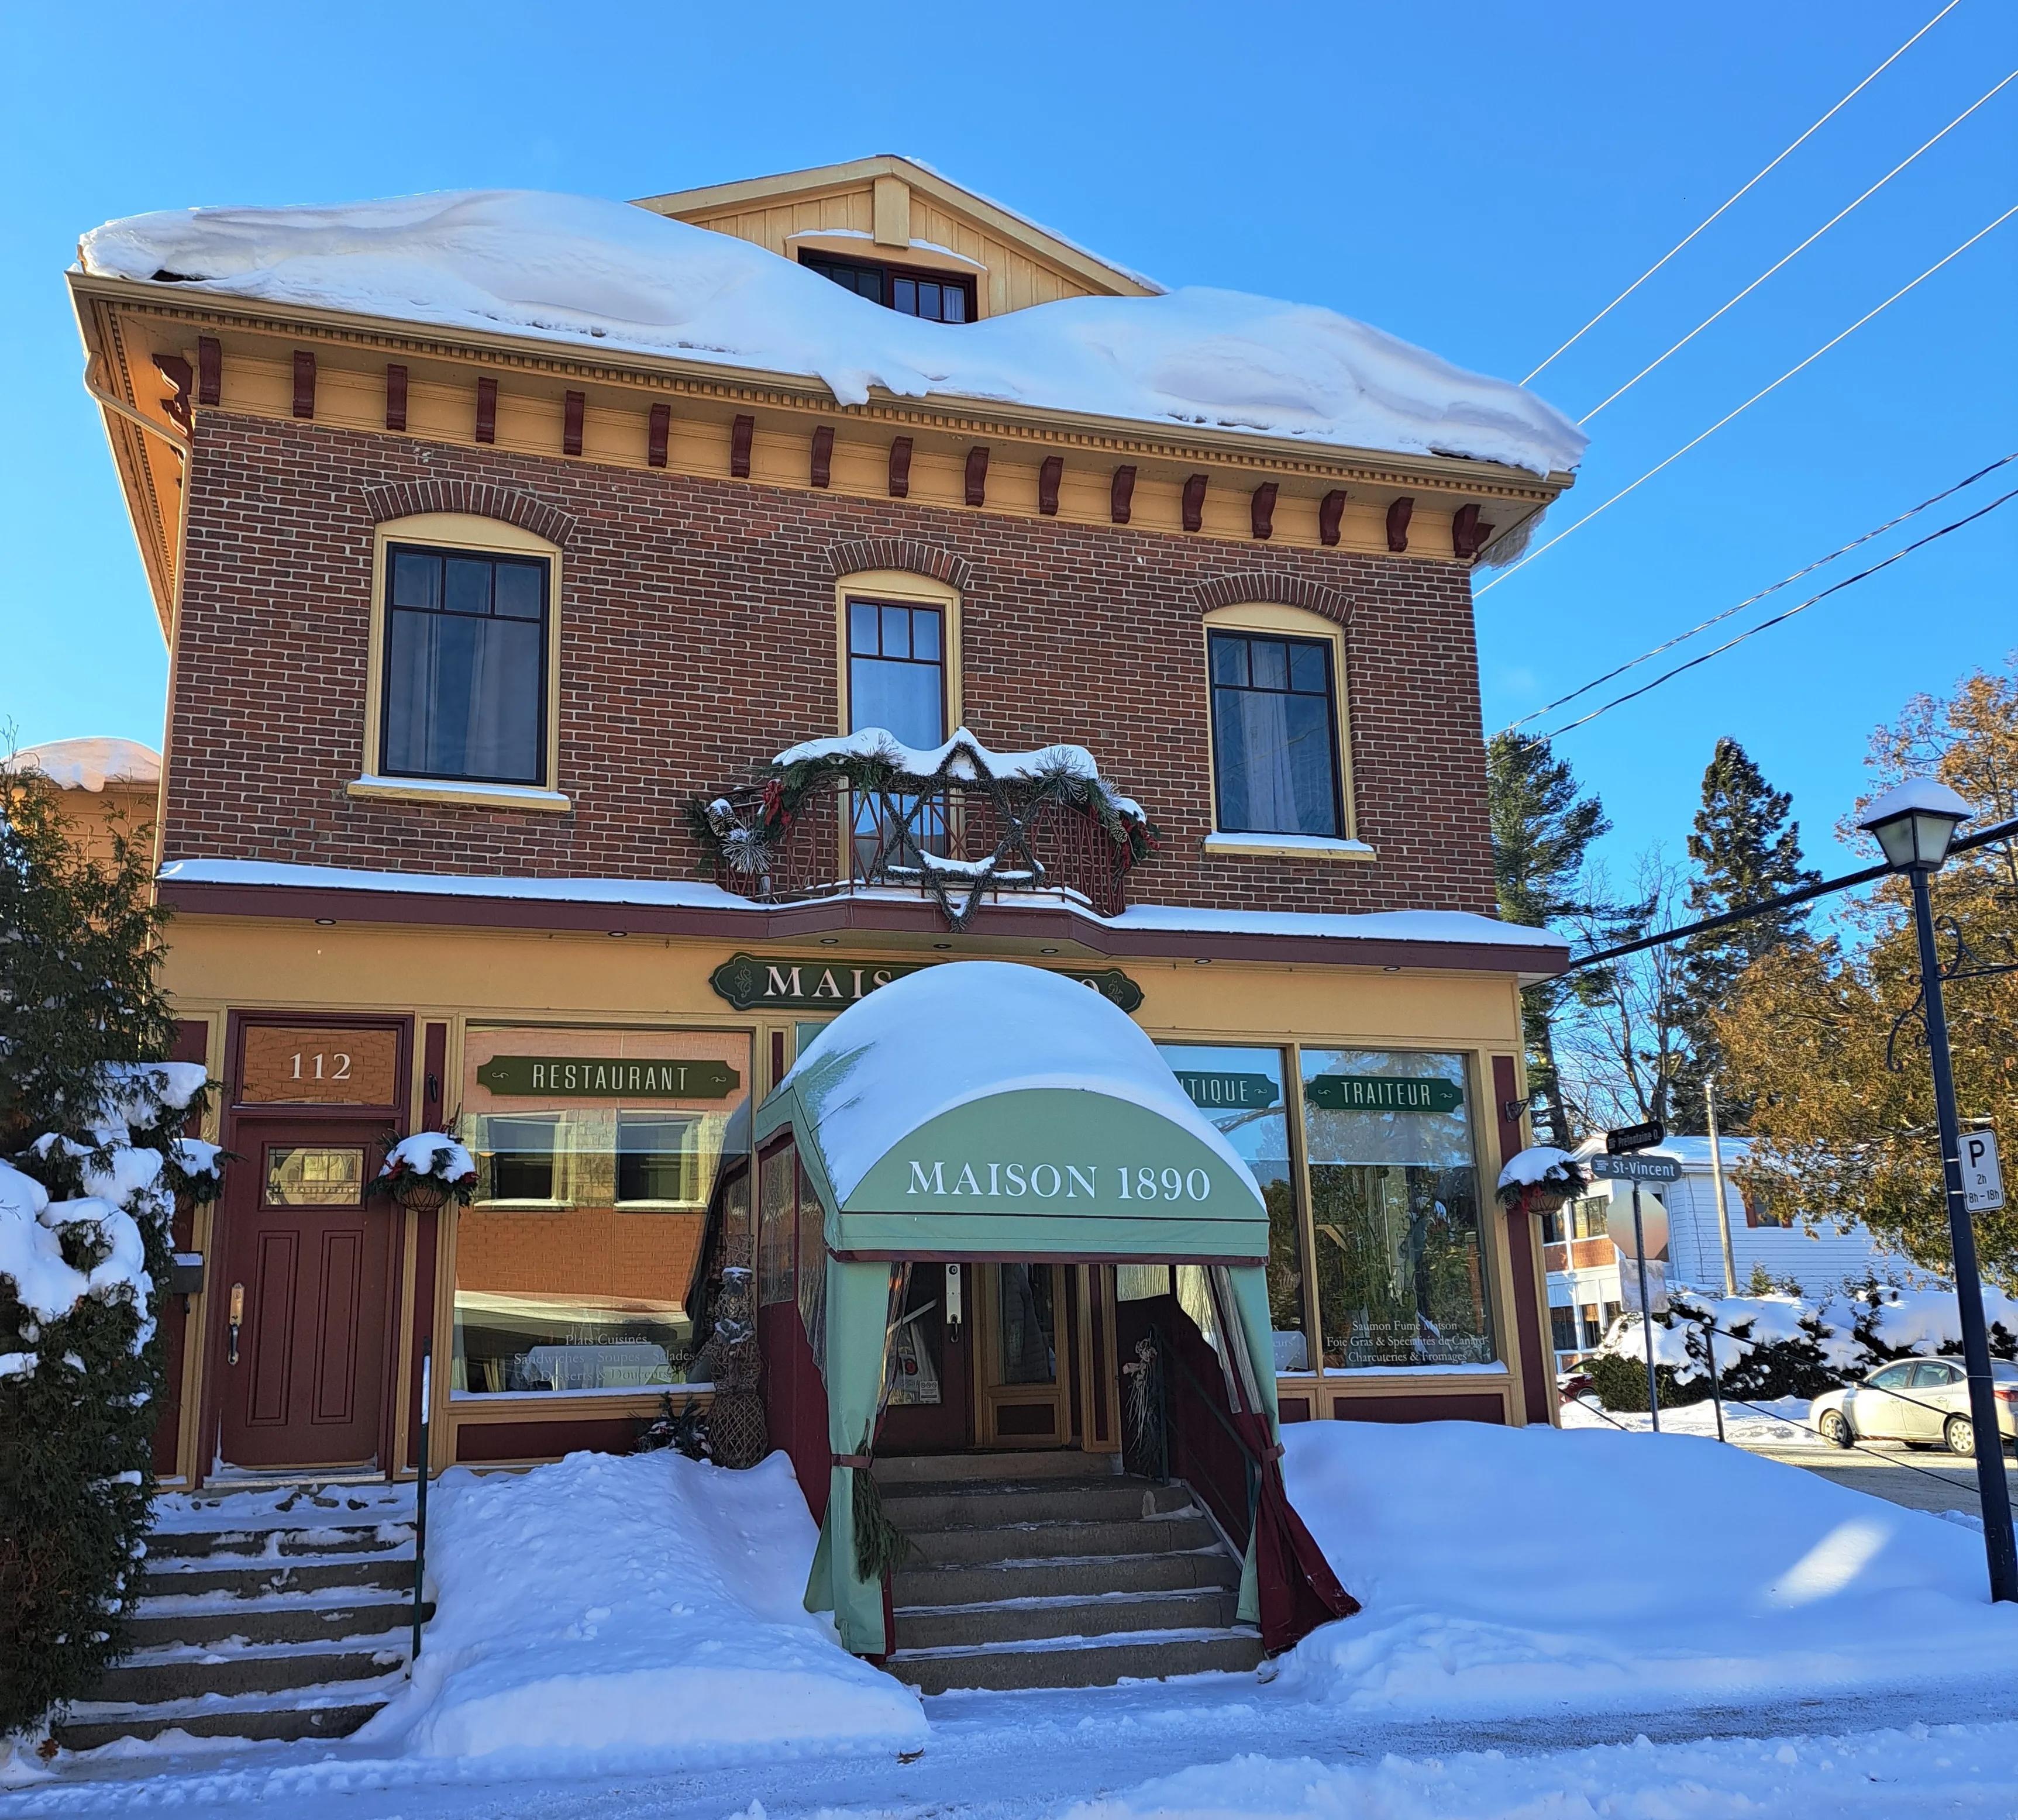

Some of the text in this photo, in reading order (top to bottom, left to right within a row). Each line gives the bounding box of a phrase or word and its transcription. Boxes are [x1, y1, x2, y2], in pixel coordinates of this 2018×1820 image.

[763, 966, 892, 998] MAIS
[289, 1053, 351, 1080] 112
[533, 1064, 688, 1091] RESTAURANT
[1180, 1078, 1248, 1104] TIQUE
[1341, 1082, 1431, 1105] TRAITEUR
[1969, 1139, 1985, 1168] P
[1613, 1160, 1675, 1177] St-Vincent
[906, 1161, 1210, 1201] MAISON 1890
[1976, 1174, 1987, 1185] 2h
[1969, 1192, 1979, 1203] 8h
[1986, 1190, 2000, 1201] 18h
[1352, 1321, 1391, 1331] Saumon
[1393, 1320, 1420, 1331] Fumé
[566, 1333, 648, 1346] Plats Cuisinés
[1326, 1336, 1348, 1347] Foie
[1350, 1336, 1373, 1346] Gras
[1376, 1336, 1385, 1346] &
[1438, 1335, 1449, 1345] de
[514, 1352, 585, 1365] Sandwiches
[597, 1351, 640, 1366] Soupes
[652, 1349, 695, 1361] Salades
[1348, 1352, 1467, 1363] Charcuteries & Fromages
[540, 1370, 593, 1382] Dsserts
[596, 1369, 606, 1380] &
